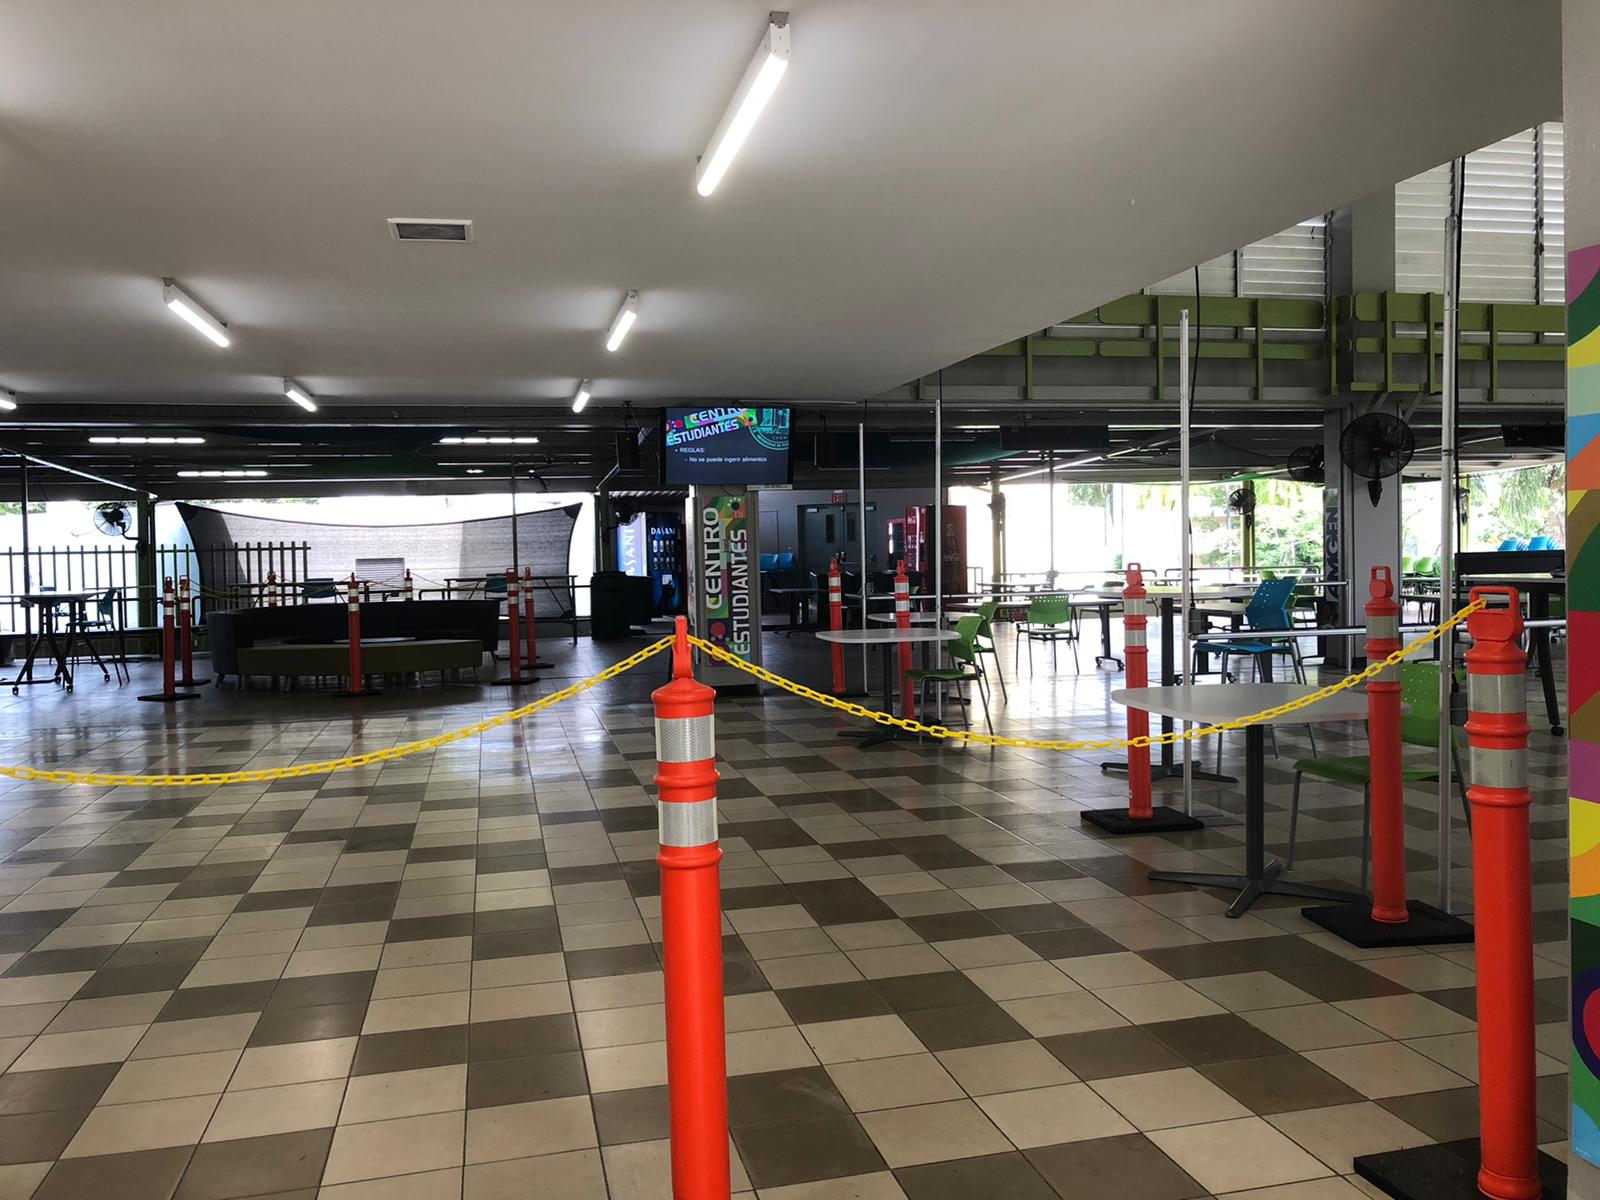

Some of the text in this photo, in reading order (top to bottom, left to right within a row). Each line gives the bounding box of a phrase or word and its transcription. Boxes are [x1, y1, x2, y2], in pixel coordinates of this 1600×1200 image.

[666, 418, 739, 445] ESTUDIANTES
[690, 408, 746, 423] CENTR
[623, 529, 638, 576] ASANI
[650, 527, 676, 536] DASANI
[1326, 507, 1339, 600] AMGEN
[703, 507, 722, 610] CENTRO
[730, 529, 750, 655] ESTUDIANTES
